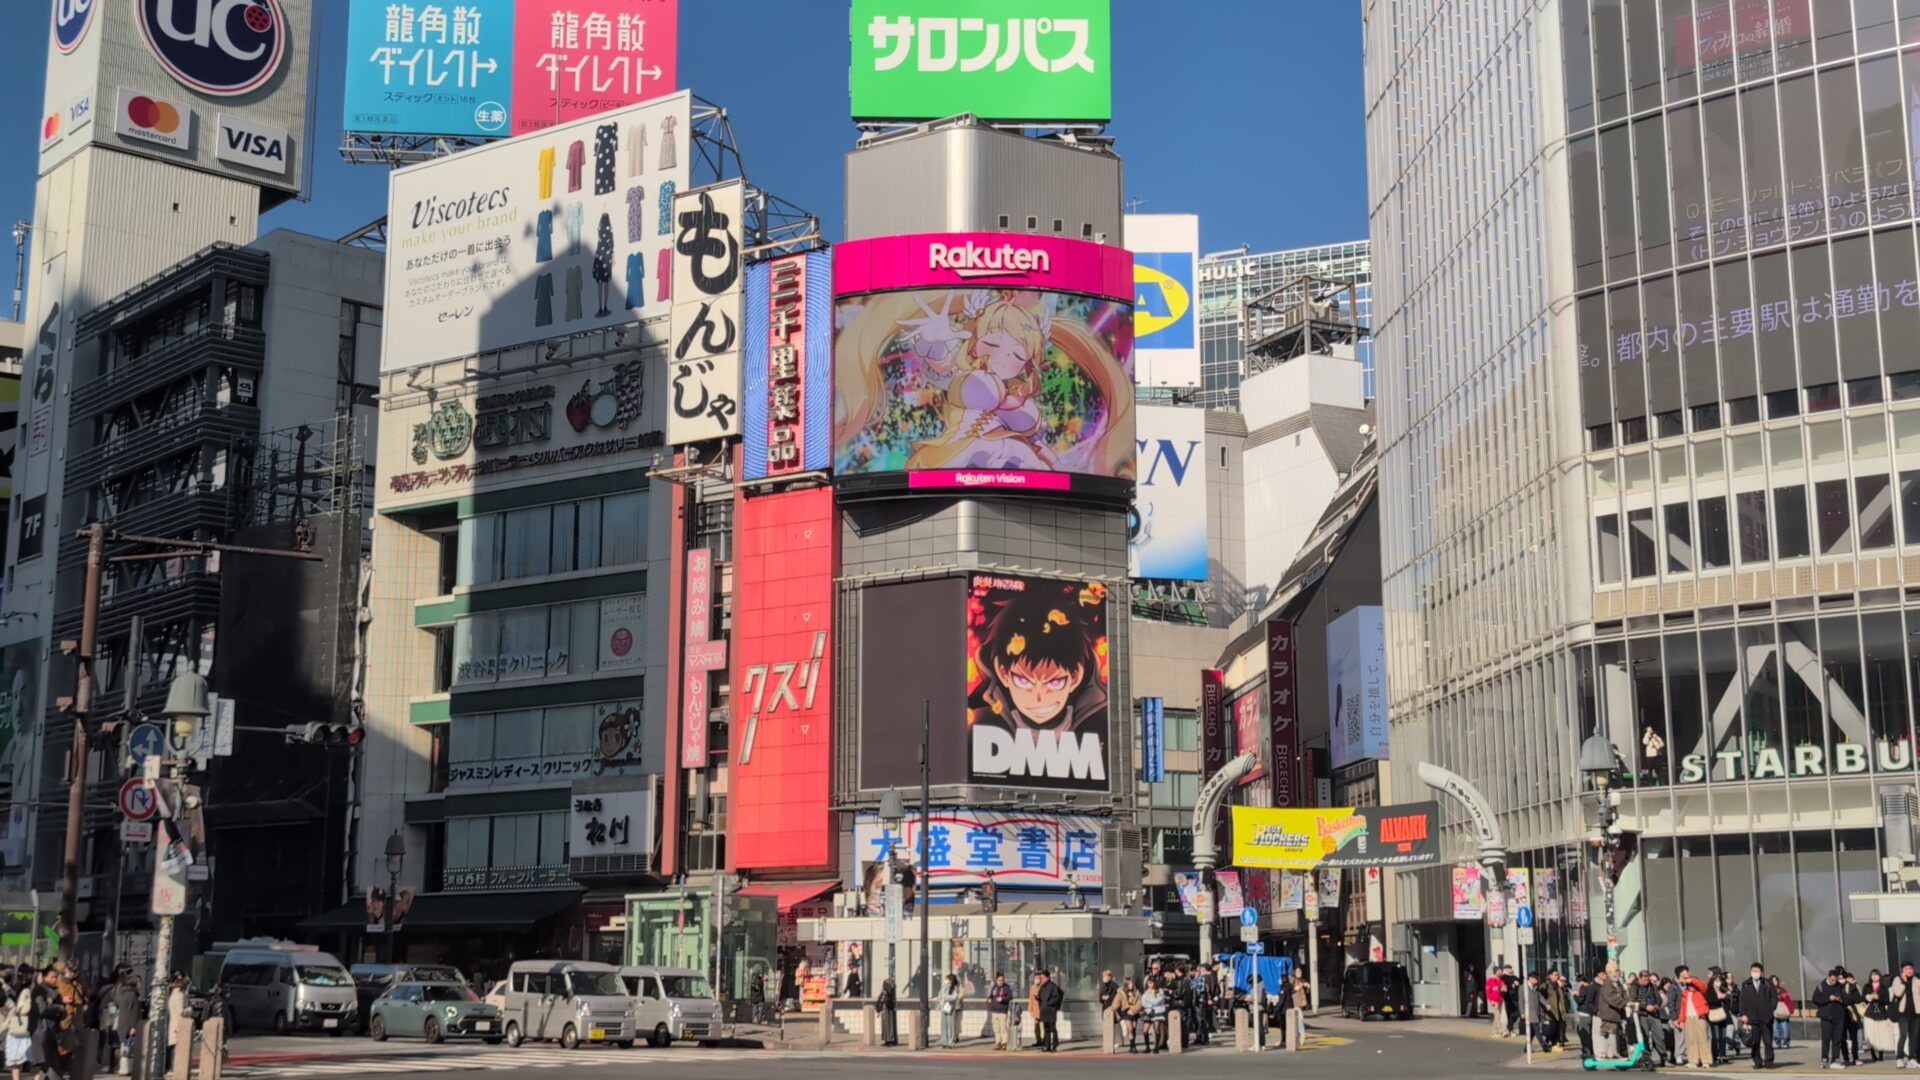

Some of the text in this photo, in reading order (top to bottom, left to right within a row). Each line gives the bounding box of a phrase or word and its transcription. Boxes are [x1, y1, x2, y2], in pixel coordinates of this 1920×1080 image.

[385, 3, 482, 45] 龍角散
[551, 10, 646, 51] 龍角散
[868, 16, 1095, 73] サロンパス
[369, 47, 498, 88] ダイレクト
[536, 53, 662, 94] ダイレクト
[69, 98, 90, 122] VISA
[476, 109, 504, 123] 生薬
[128, 127, 177, 144] mastercard
[221, 126, 283, 161] VISA
[401, 206, 518, 249] make your brand
[411, 186, 510, 230] Viscotecs
[929, 241, 1049, 276] Rakuten
[676, 191, 737, 433] もんじゃ
[768, 260, 798, 464] 三千里薬品
[955, 473, 1025, 484] Rakuten Vision
[24, 511, 42, 539] 7F
[738, 630, 828, 765] クスリ
[1271, 634, 1293, 733] カラオケ
[972, 724, 1106, 780] DMM
[870, 824, 1098, 874] 大盛堂書店
